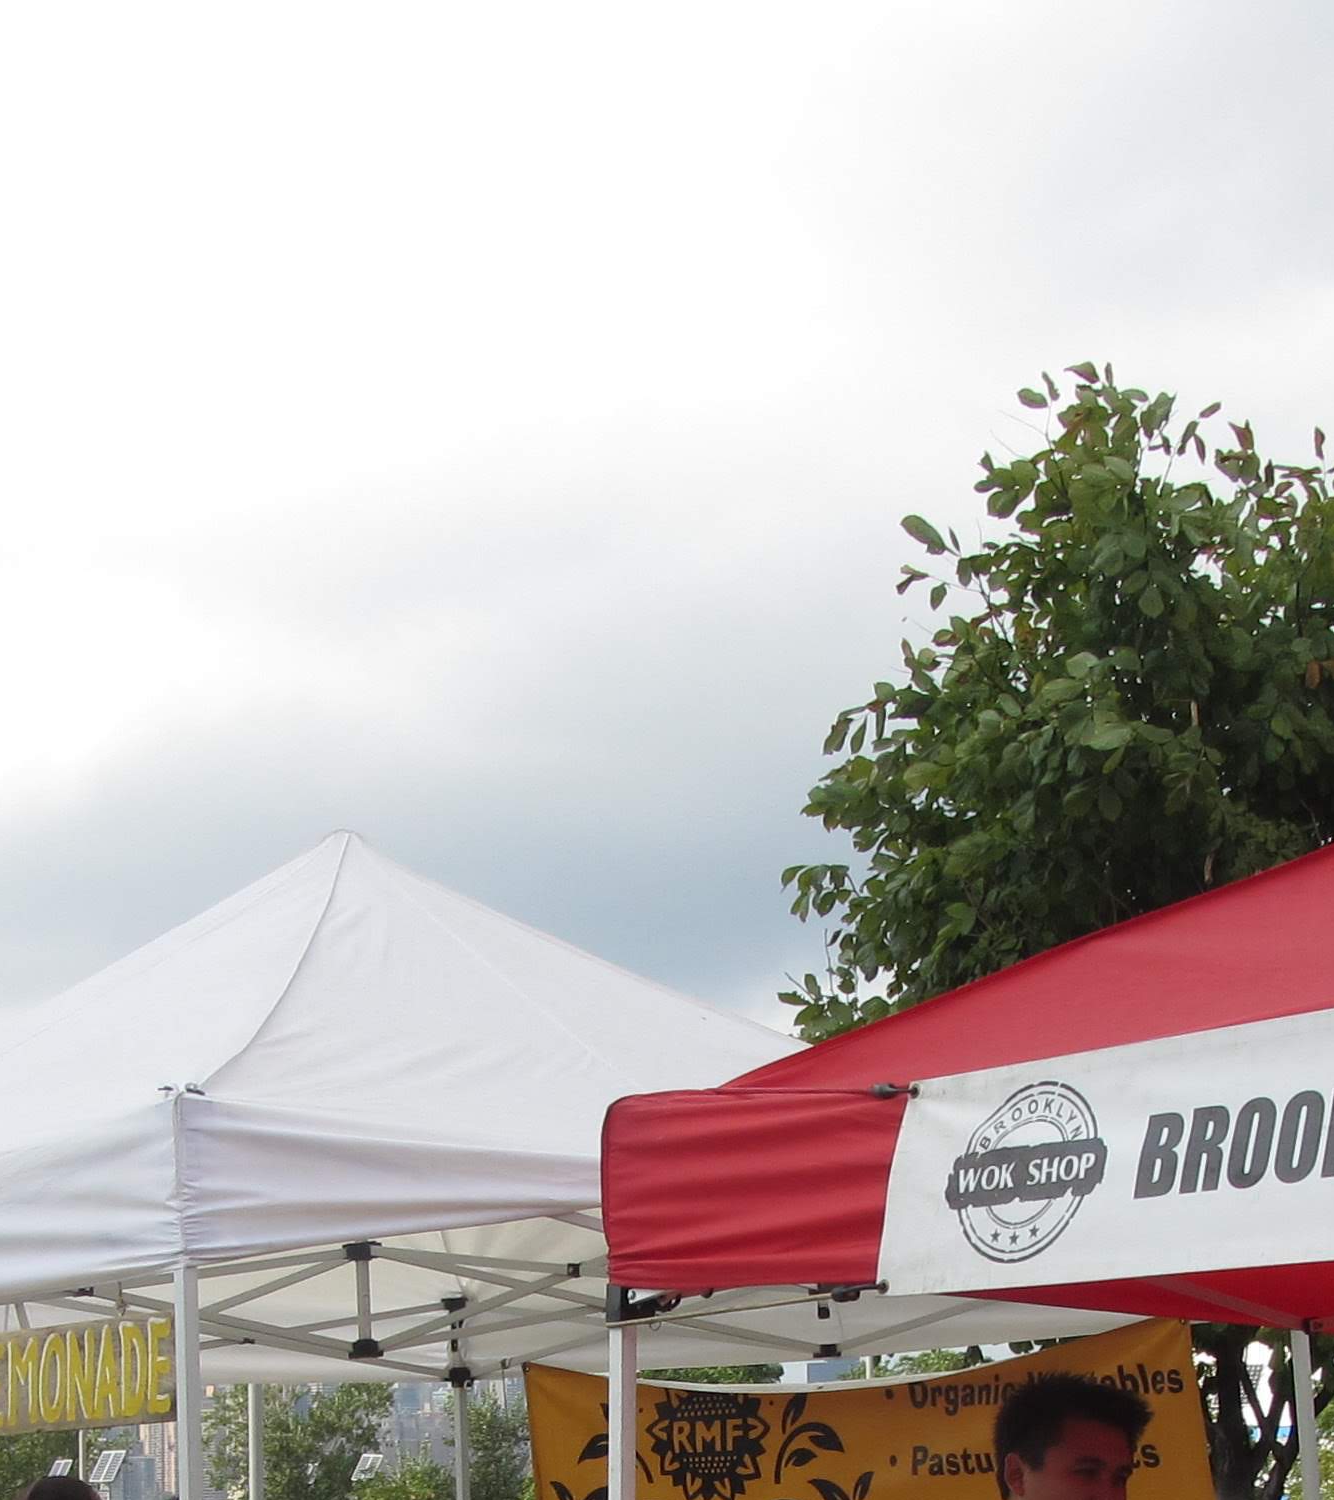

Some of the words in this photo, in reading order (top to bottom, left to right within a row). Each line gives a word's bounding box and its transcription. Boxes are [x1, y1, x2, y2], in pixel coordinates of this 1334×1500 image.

[978, 1097, 1084, 1150] BROOKLYN
[958, 1162, 1015, 1194] WOK
[1026, 1152, 1096, 1186] SHOP
[672, 1418, 743, 1454] RMF
